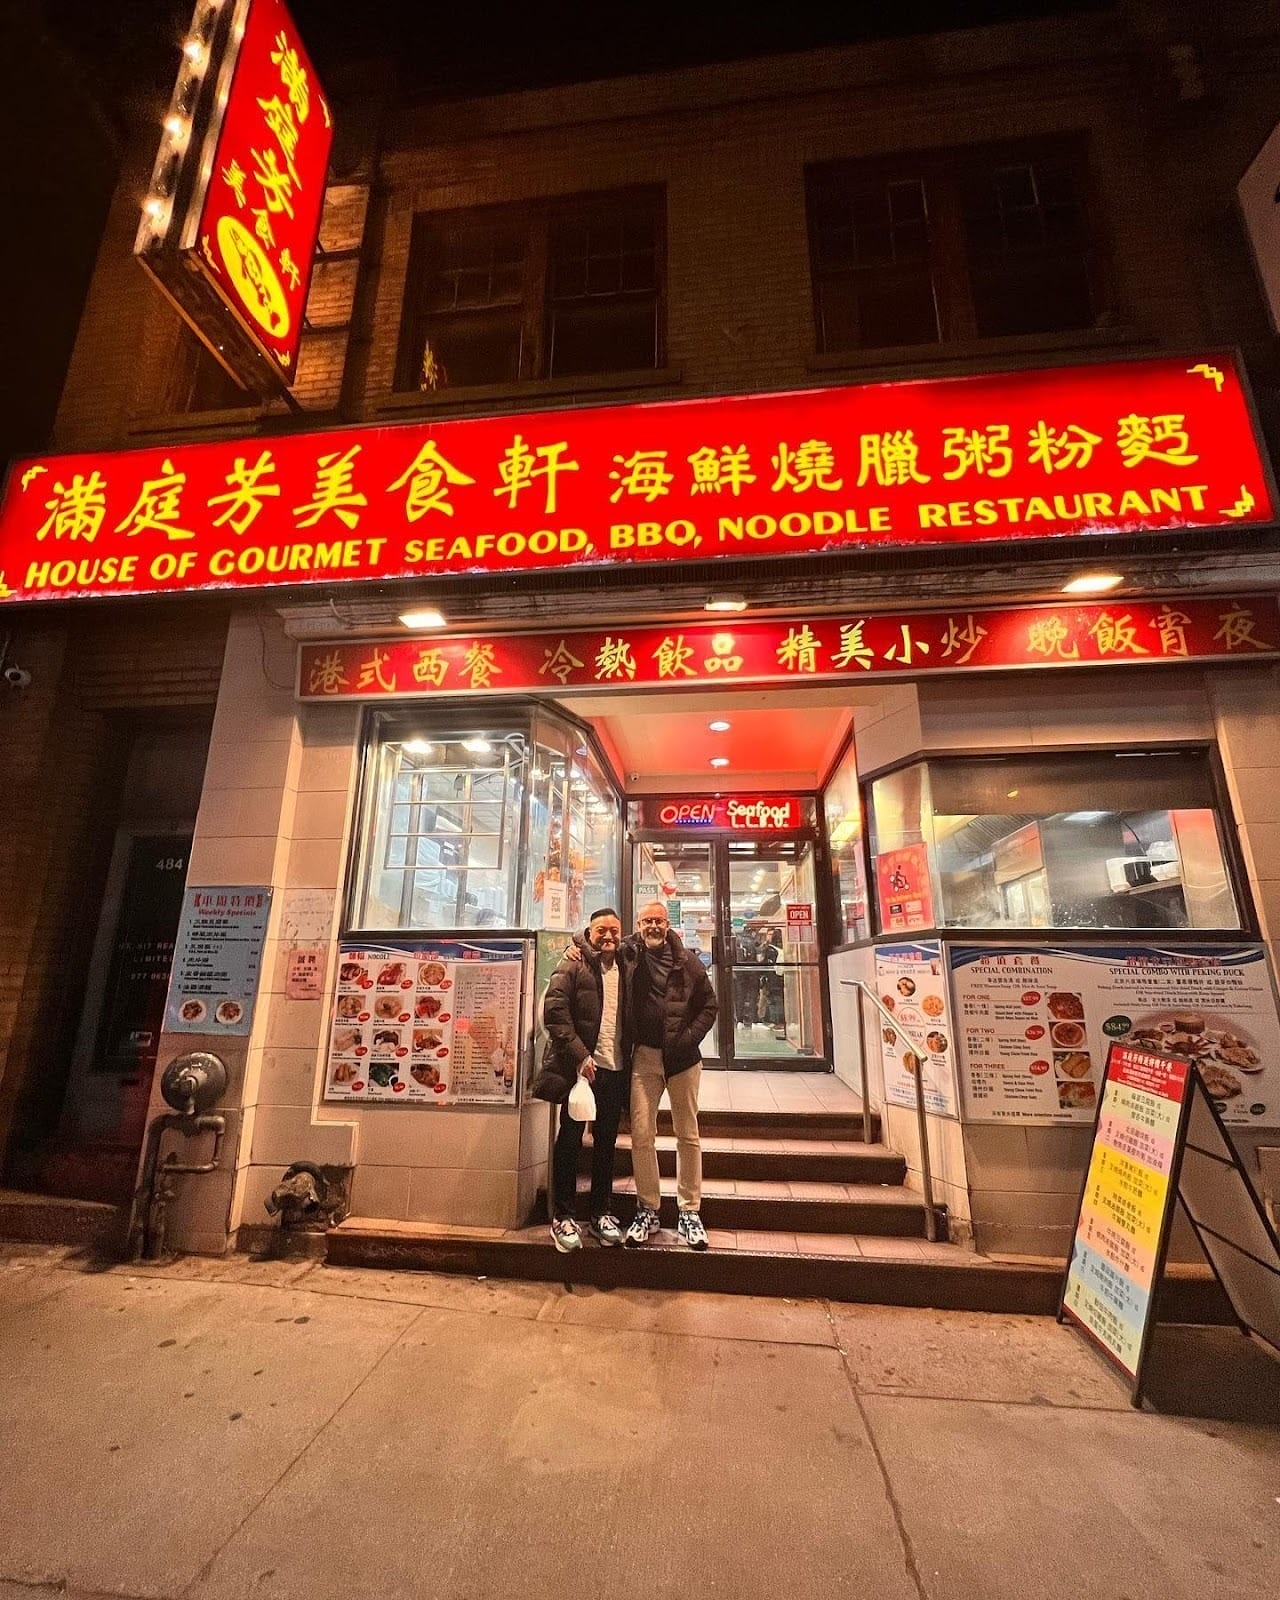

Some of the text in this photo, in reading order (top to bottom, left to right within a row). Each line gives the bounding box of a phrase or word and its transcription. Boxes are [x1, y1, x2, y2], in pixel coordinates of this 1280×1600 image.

[25, 486, 1207, 588] HOUSE OF GOURMET SEAFOOD, BBQ, NOODLE RESTAURANT
[309, 602, 1278, 694] 港式西餐 冷熱飲品 精美小炒 晚飯宵夜
[660, 804, 715, 823] OPEN
[726, 800, 791, 819] Seafood
[155, 858, 183, 870] 484
[198, 909, 225, 917] Weekly
[790, 910, 809, 919] OPEN
[970, 966, 1053, 974] SPECIAL COMBINATION
[1109, 967, 1140, 975] SPECIAL
[1141, 967, 1169, 976] COMBO
[1170, 968, 1190, 976] WITH
[1223, 969, 1245, 977] DUCK
